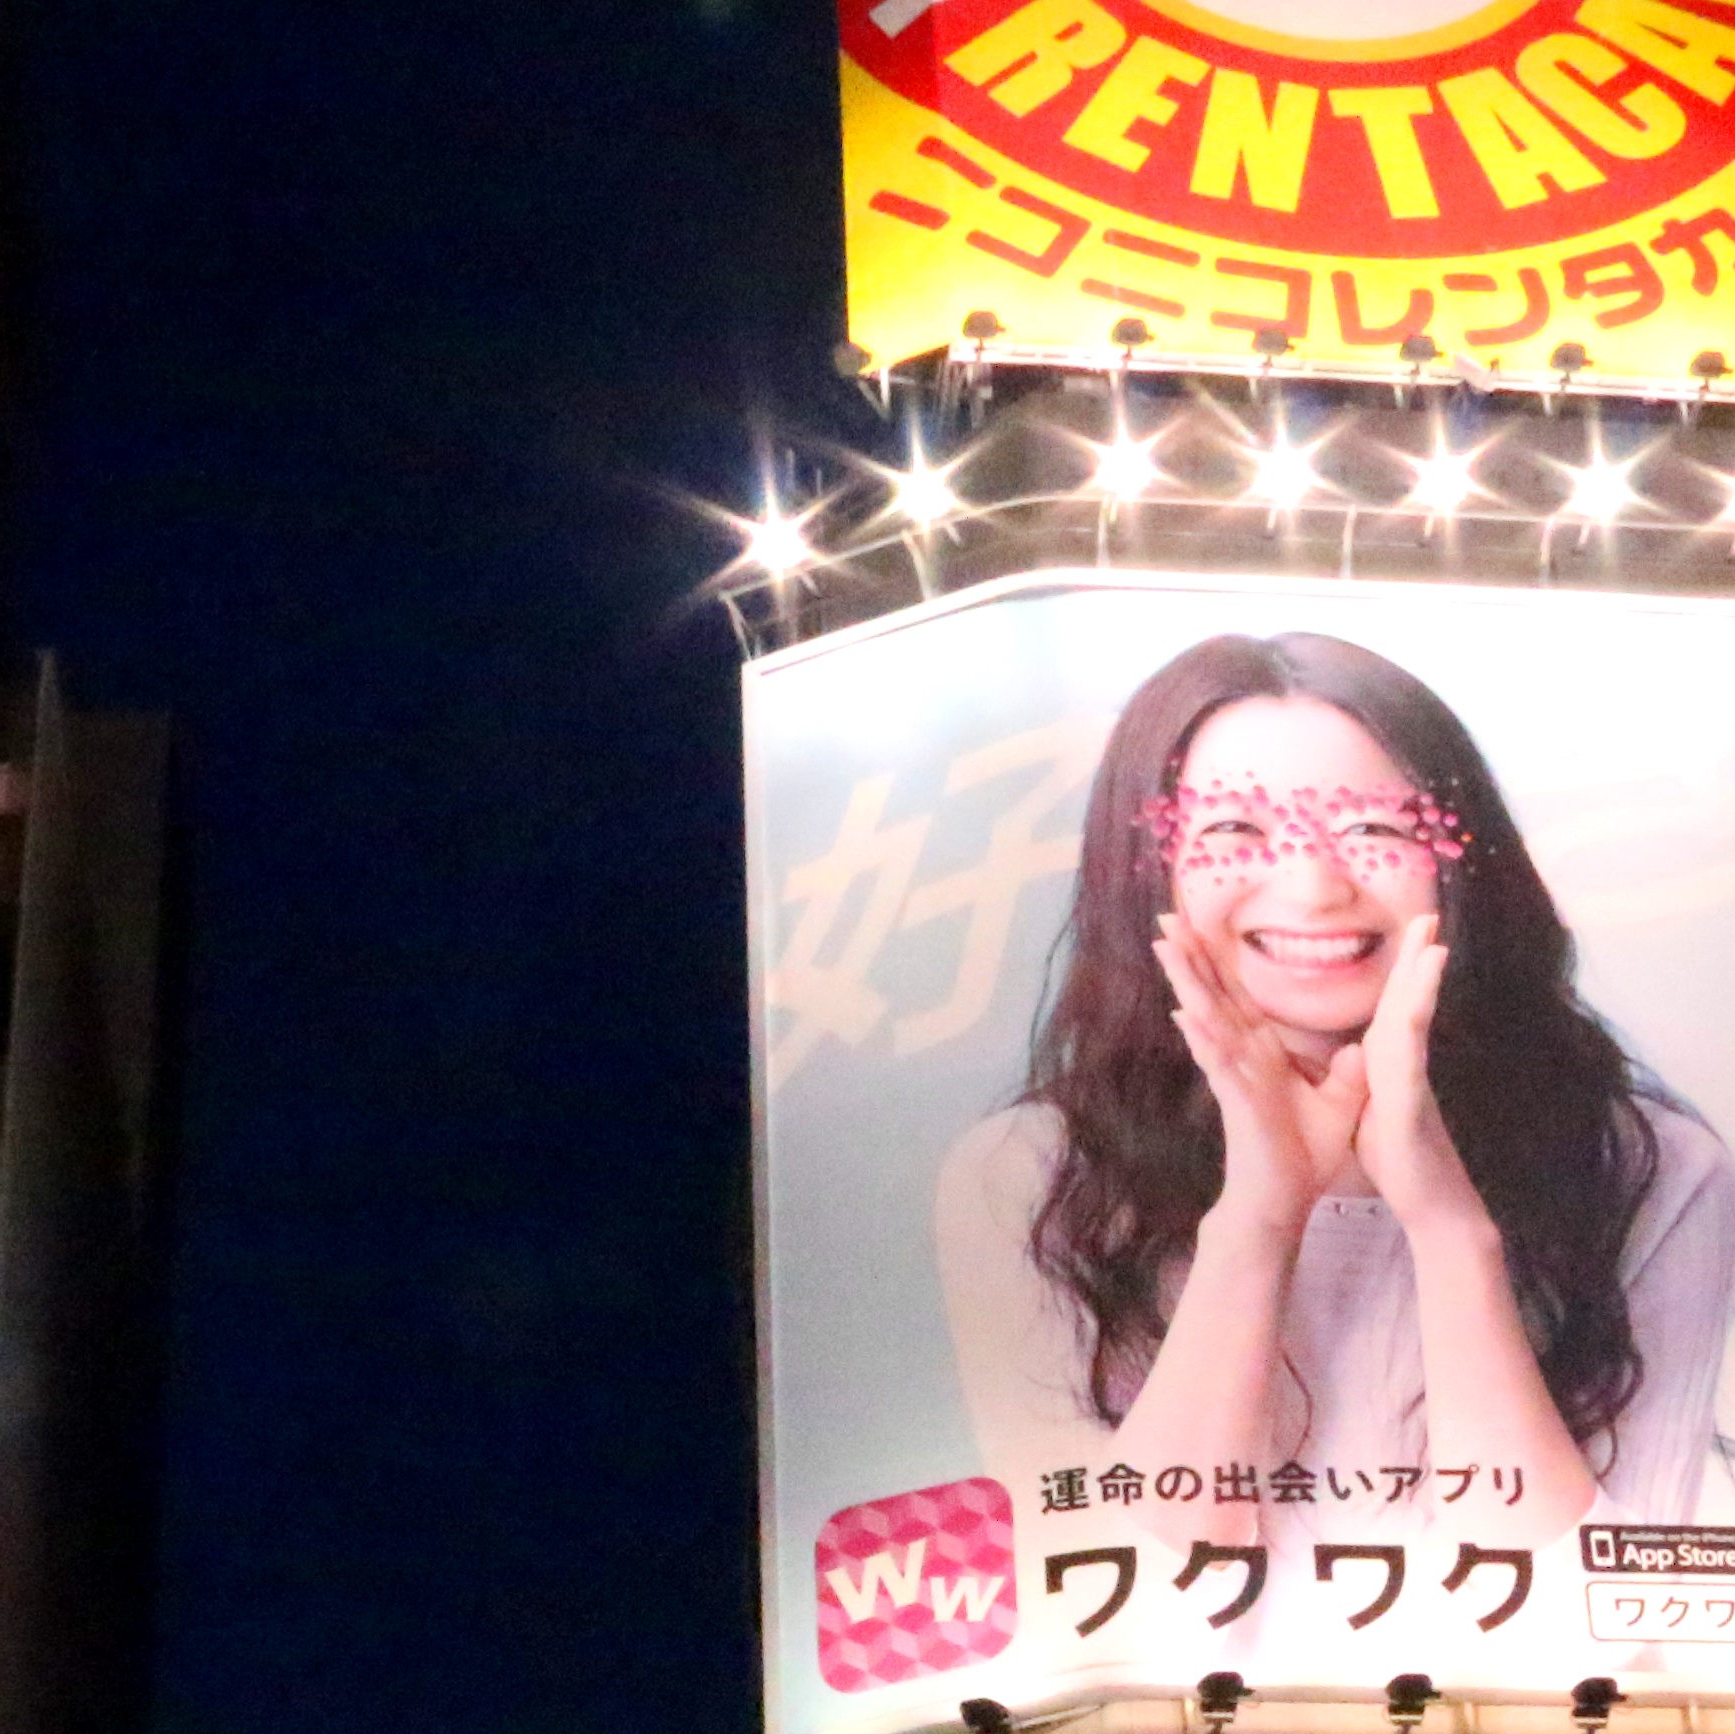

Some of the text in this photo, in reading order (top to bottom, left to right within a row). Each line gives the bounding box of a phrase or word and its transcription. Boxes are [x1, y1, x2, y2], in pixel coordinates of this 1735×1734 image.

[1040, 1461, 1527, 1517] 運命の出会いアプリ
[1623, 1544, 1674, 1571] App
[1044, 1540, 1535, 1638] ワクワク
